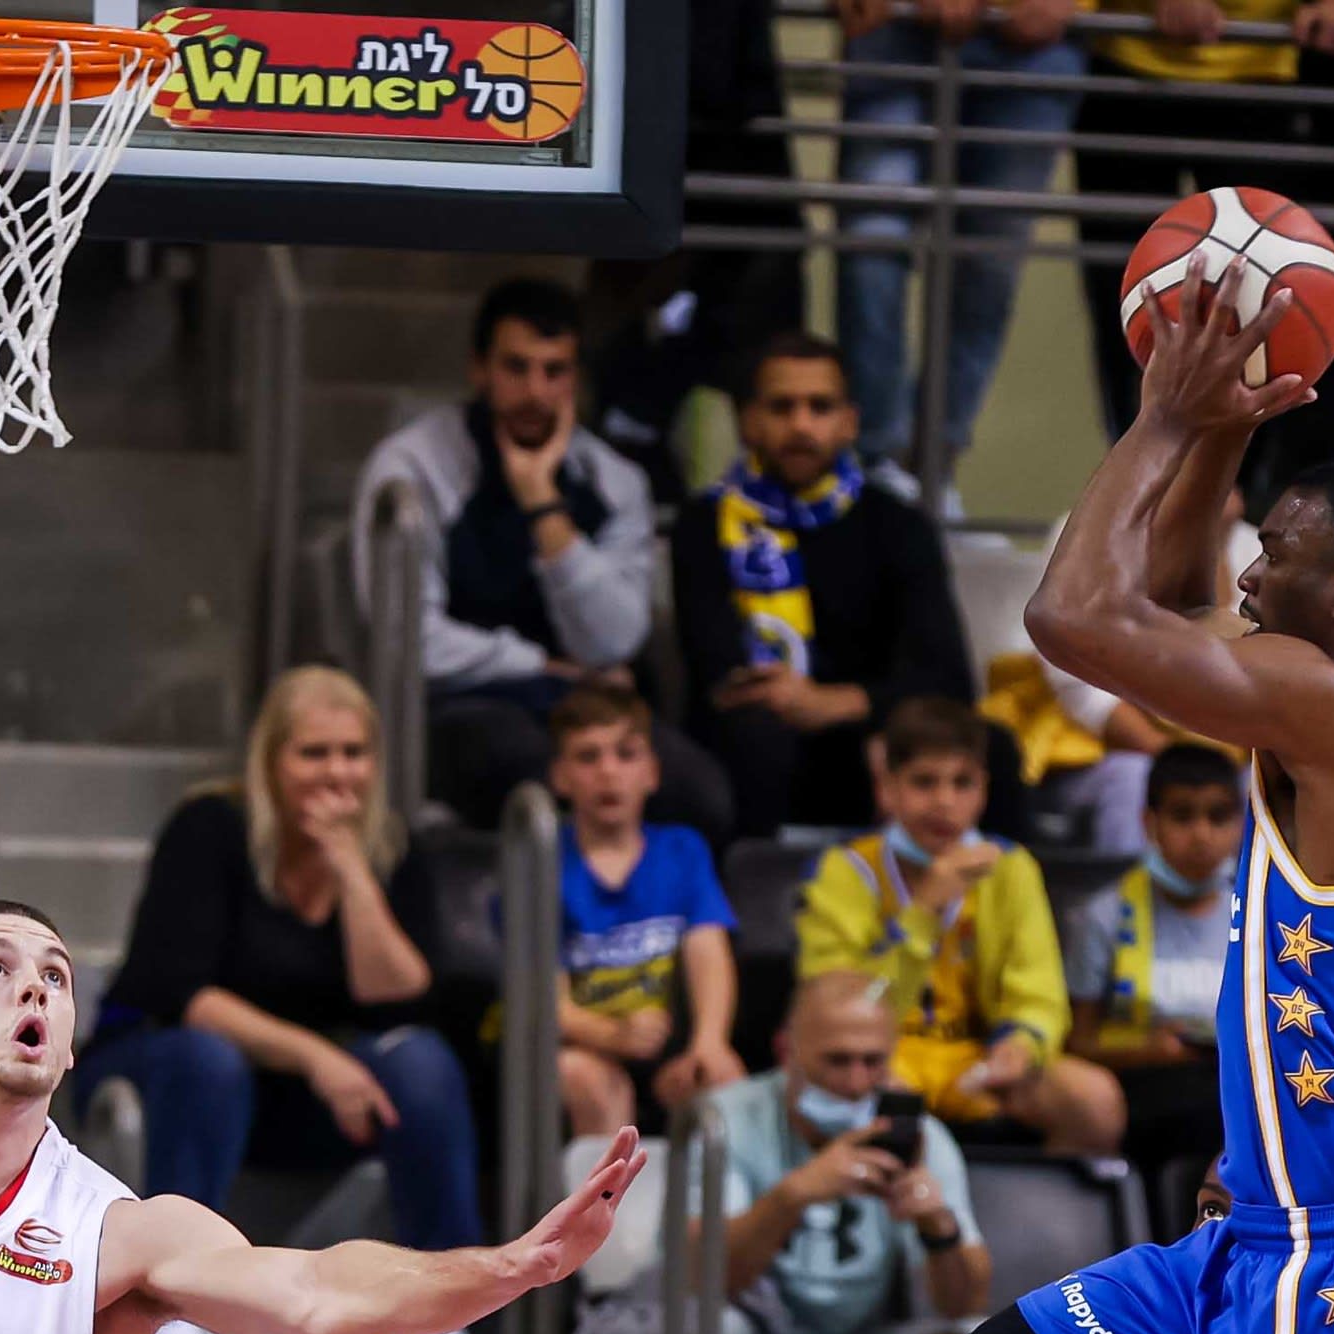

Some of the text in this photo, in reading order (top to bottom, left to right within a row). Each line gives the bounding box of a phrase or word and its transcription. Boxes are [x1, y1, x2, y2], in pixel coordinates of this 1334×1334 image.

[358, 31, 450, 74] ליגת
[186, 40, 527, 116] Winner סל
[1290, 1003, 1303, 1014] 05
